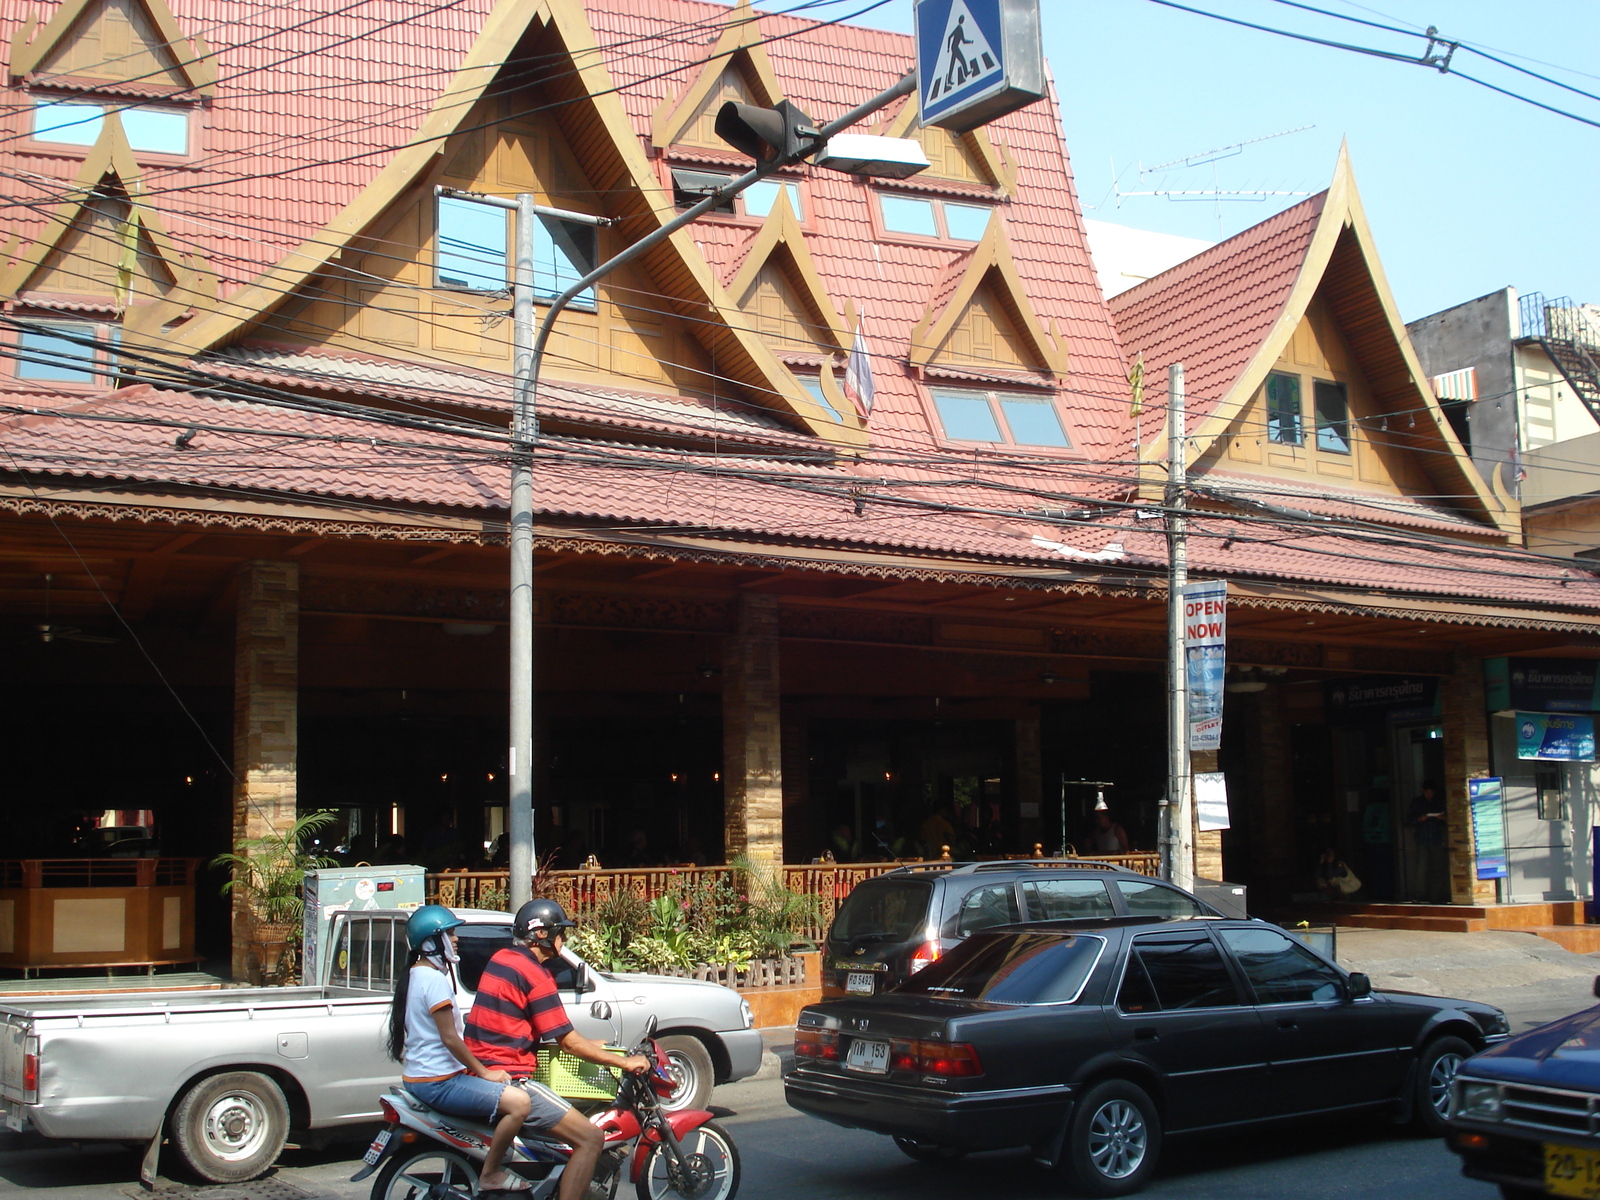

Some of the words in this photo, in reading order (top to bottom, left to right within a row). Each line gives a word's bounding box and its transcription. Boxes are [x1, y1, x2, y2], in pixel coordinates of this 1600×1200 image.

[1186, 600, 1224, 617] OPEN
[1187, 622, 1223, 640] NOW
[858, 974, 872, 985] 5492
[871, 1043, 886, 1059] 153
